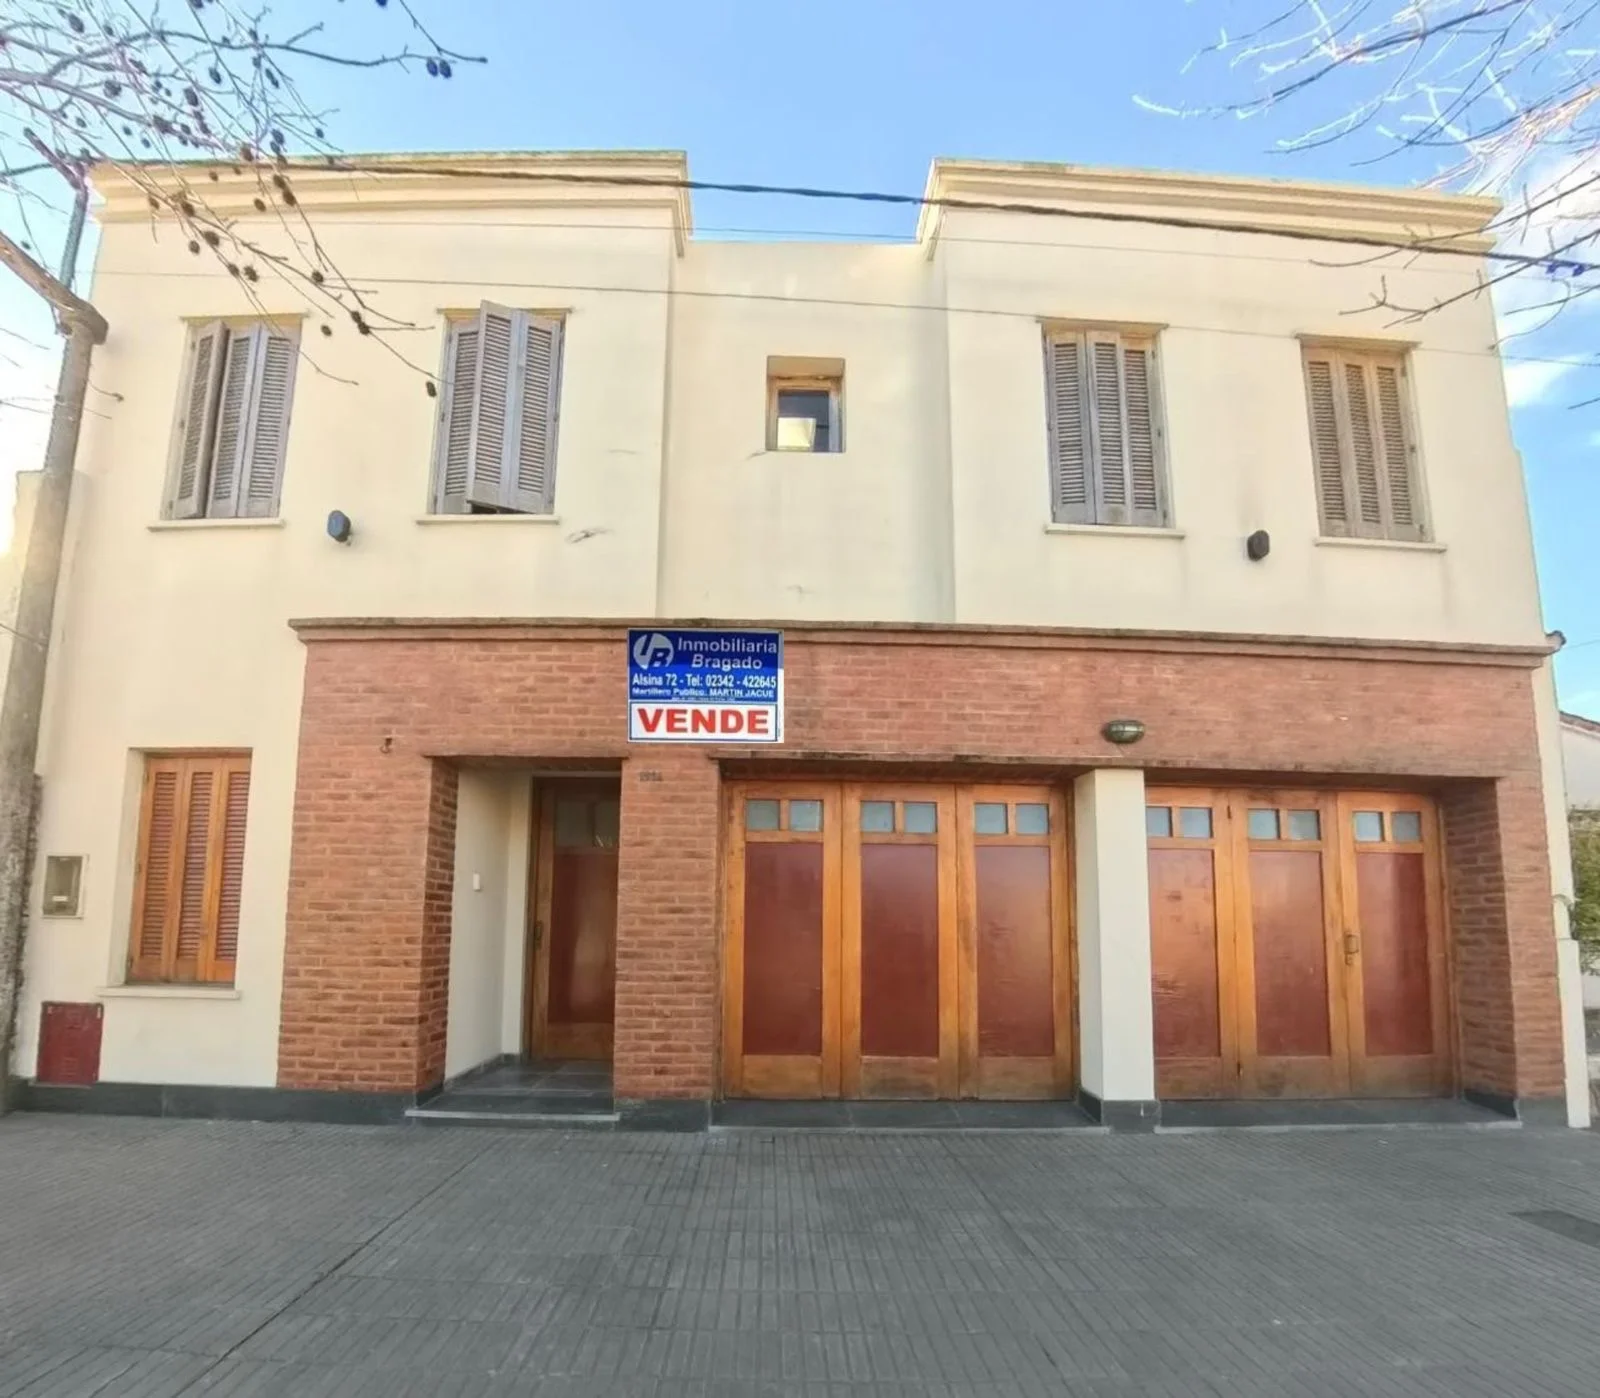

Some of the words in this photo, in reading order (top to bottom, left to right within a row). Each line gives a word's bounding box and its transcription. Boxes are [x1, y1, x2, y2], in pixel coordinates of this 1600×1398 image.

[678, 637, 777, 654] Inmobiliaria
[691, 654, 763, 671] Bragado
[632, 673, 663, 686] Alsina
[666, 673, 677, 686] 72
[685, 673, 703, 687] Tel:
[705, 674, 734, 687] 02342
[743, 675, 777, 689] 422645
[709, 688, 743, 697] MARTIN
[637, 708, 769, 734] VENDE
